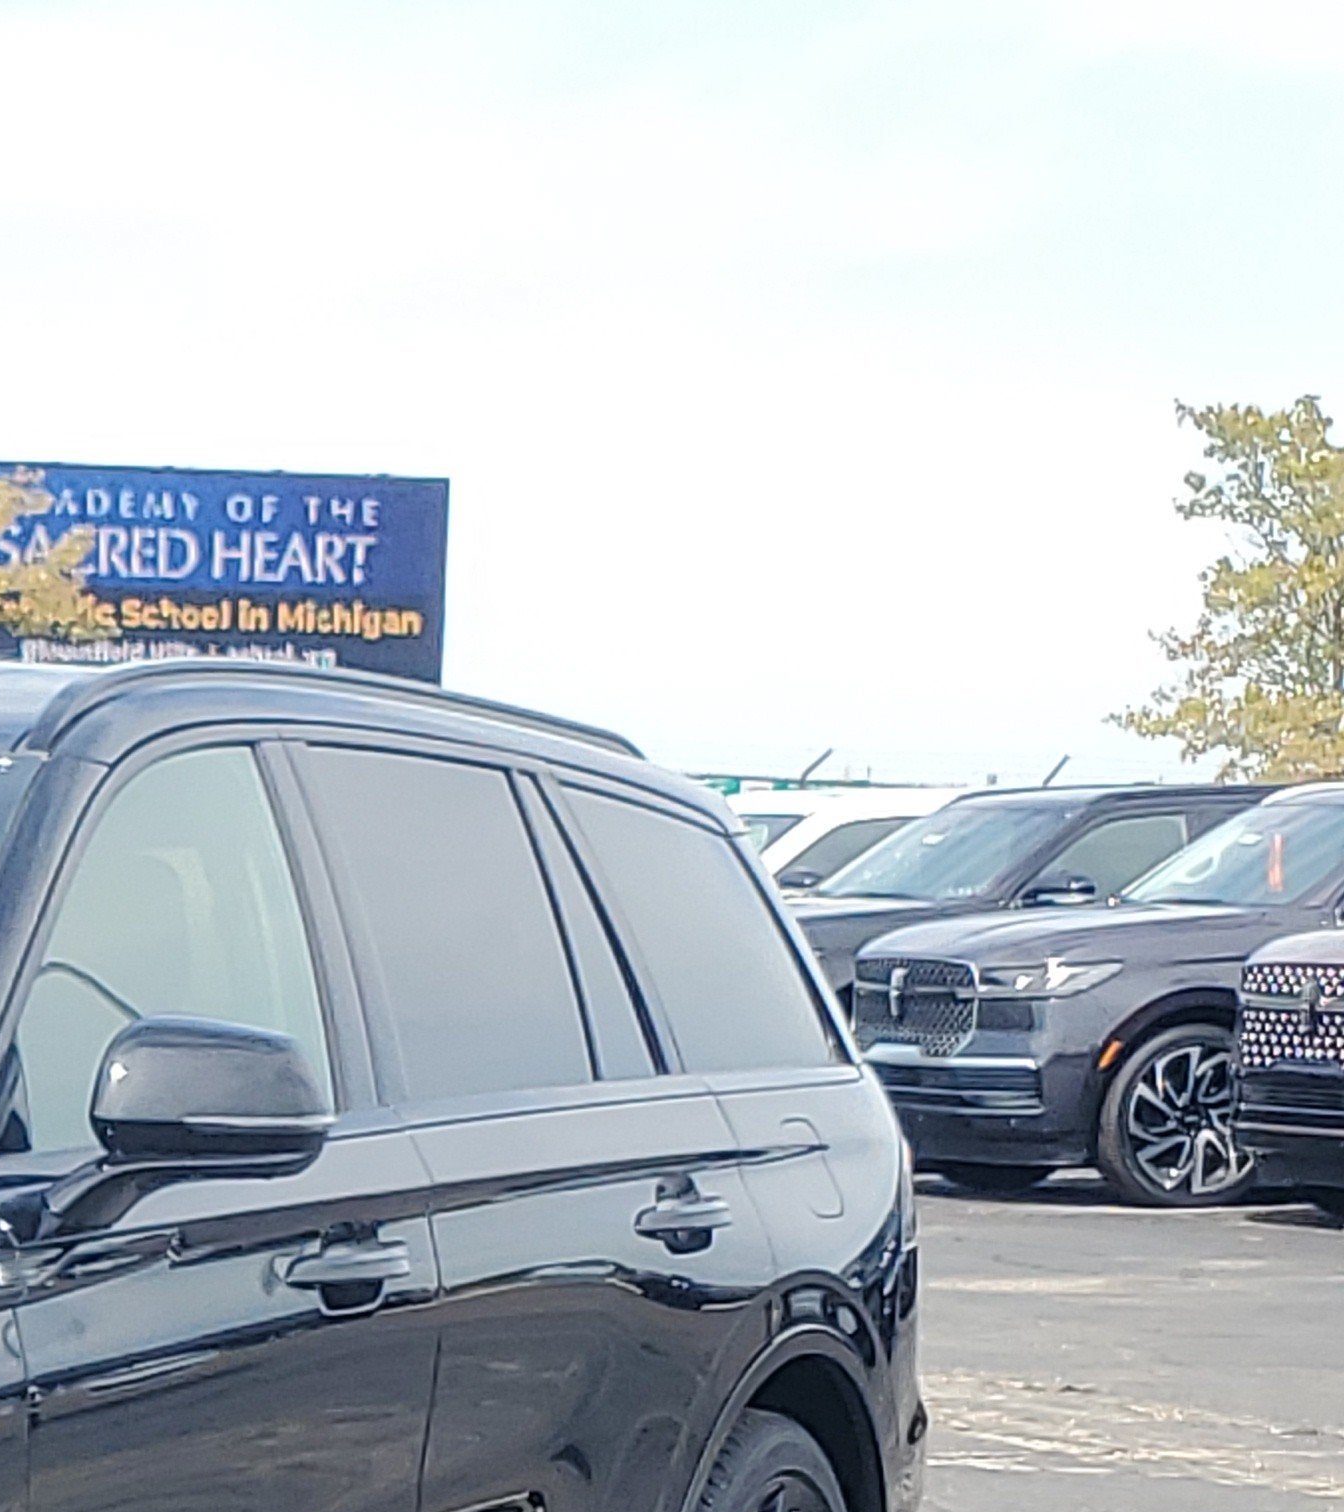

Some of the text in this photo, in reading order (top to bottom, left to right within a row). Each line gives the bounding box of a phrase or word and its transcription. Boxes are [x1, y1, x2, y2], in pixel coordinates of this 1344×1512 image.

[225, 493, 280, 524] OF
[303, 495, 383, 528] THE
[211, 528, 379, 586] HEART
[119, 595, 233, 633] School
[237, 598, 270, 633] in
[277, 598, 425, 642] Michigan
